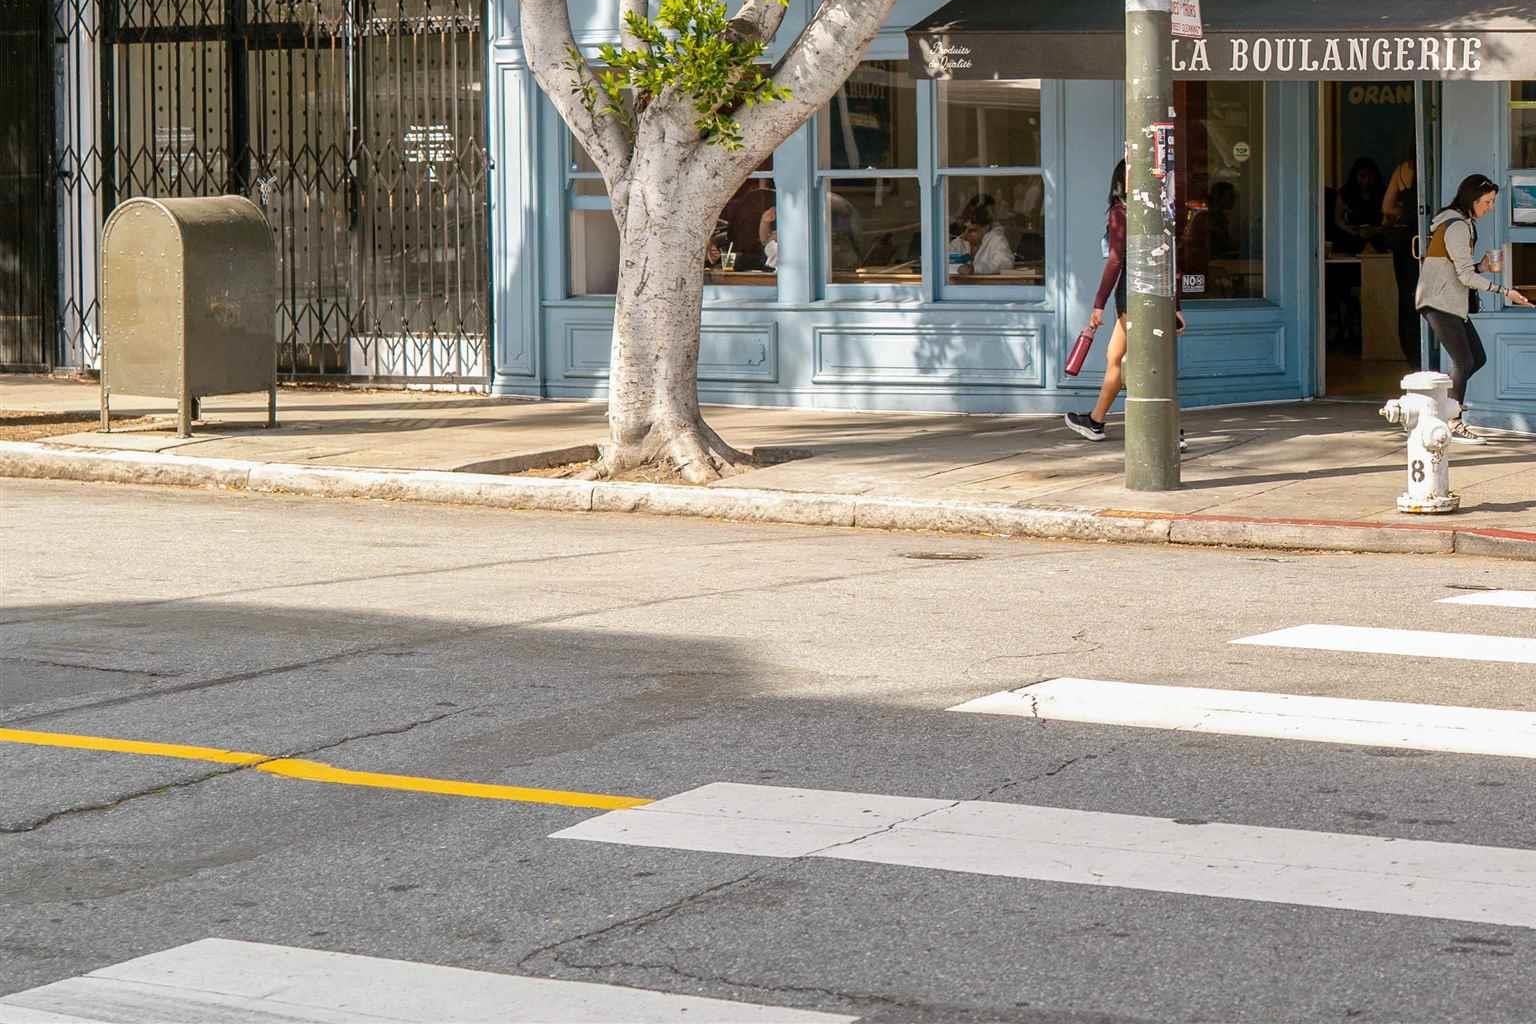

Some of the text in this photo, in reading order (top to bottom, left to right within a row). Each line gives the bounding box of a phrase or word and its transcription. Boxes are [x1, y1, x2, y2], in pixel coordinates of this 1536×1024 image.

[1171, 37, 1482, 71] LA BOULANGERIE
[1411, 459, 1425, 483] 8
